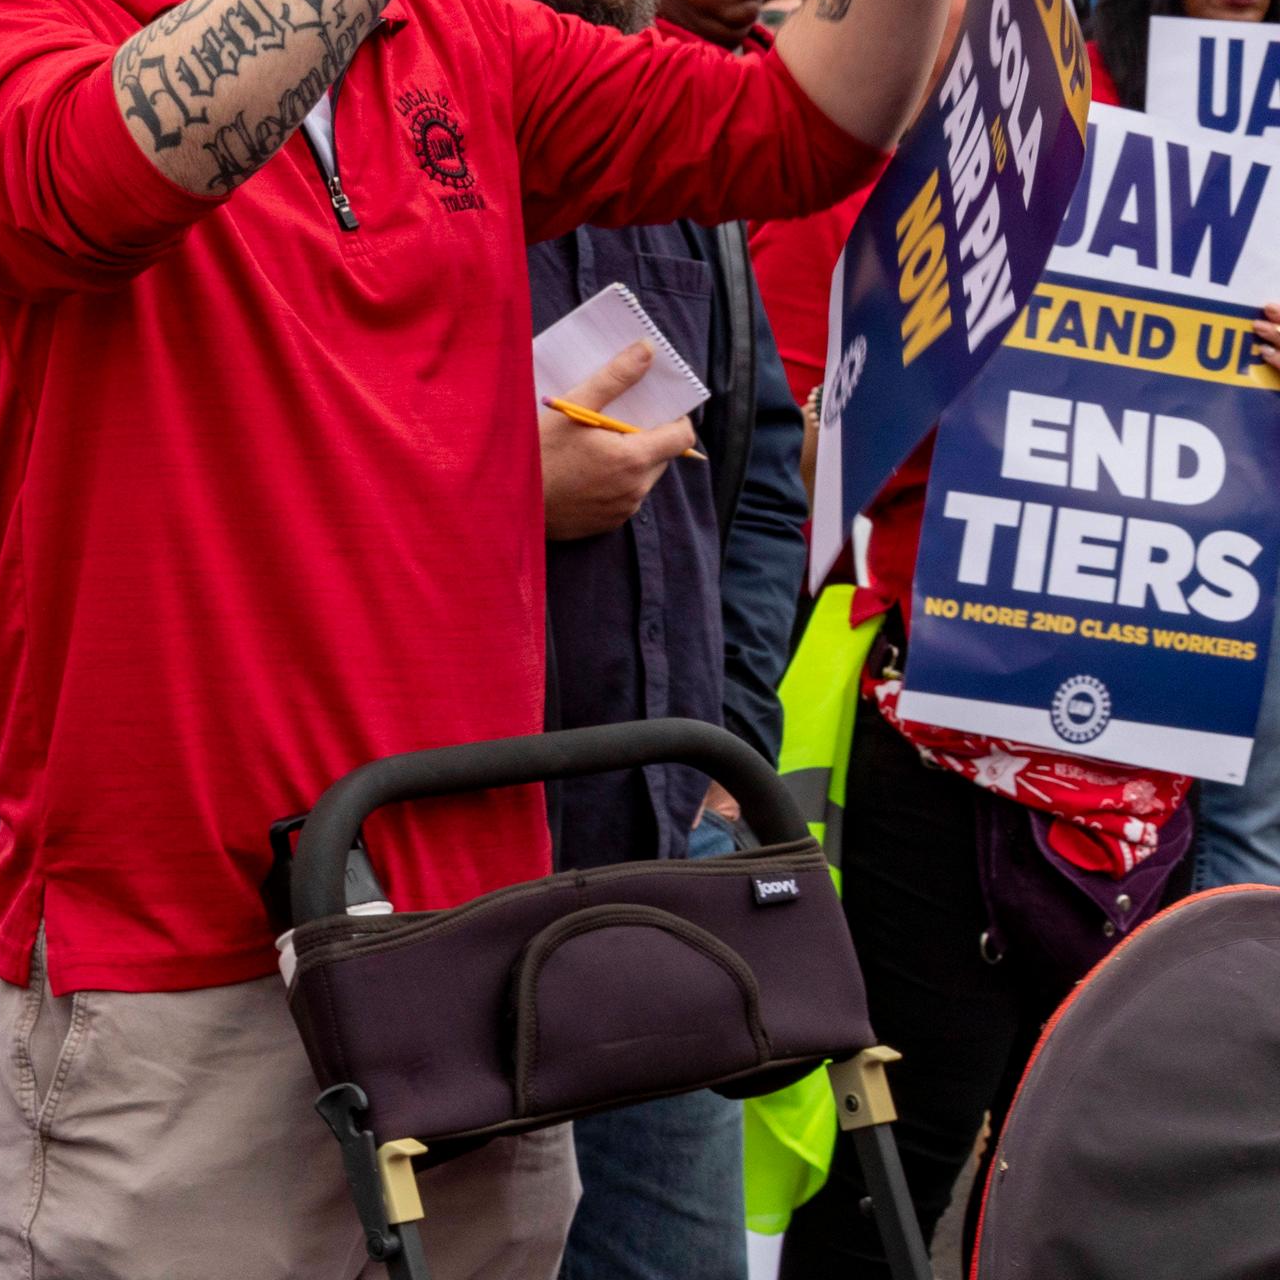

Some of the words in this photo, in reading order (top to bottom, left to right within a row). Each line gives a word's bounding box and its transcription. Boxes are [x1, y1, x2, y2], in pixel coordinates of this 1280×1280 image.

[395, 87, 436, 117] LOCAL
[939, 31, 991, 232] FAIR
[1197, 37, 1280, 136] UA
[990, 113, 1008, 174] AND
[896, 168, 953, 369] NOW
[959, 182, 1017, 354] PAY
[1026, 293, 1177, 361] TAND
[1000, 390, 1227, 506] END
[943, 490, 1264, 623] TIERS
[924, 596, 959, 619] NO
[962, 604, 1028, 630] MORE
[1030, 612, 1077, 636] 2ND
[1080, 619, 1148, 646] CLASS
[1152, 628, 1257, 661] WORKERS
